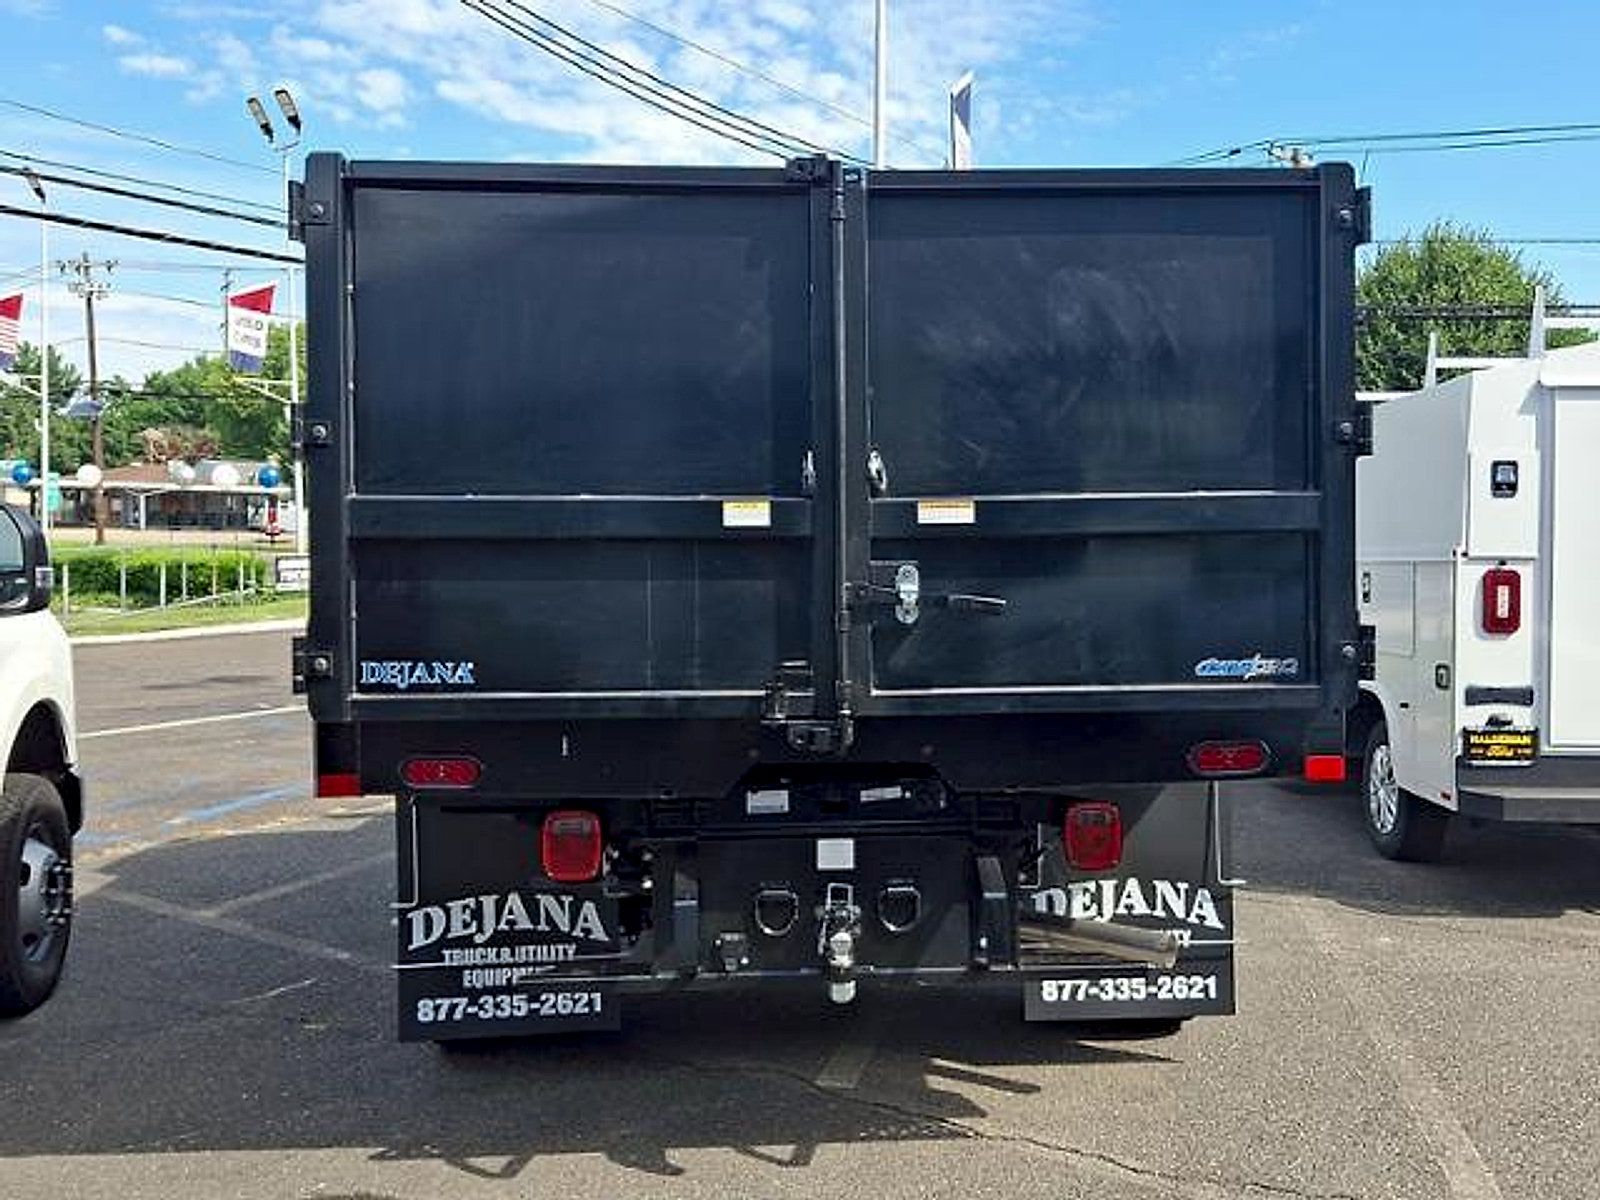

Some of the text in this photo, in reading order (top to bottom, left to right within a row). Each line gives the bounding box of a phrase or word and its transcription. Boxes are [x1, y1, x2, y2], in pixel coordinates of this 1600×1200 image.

[360, 661, 475, 688] DEJANA
[407, 891, 609, 951] DEJANA
[441, 947, 498, 966] TRUCK
[514, 943, 577, 962] UTILITY
[1041, 975, 1217, 1002] 877-335-2621
[416, 992, 602, 1022] 877-335-2621
